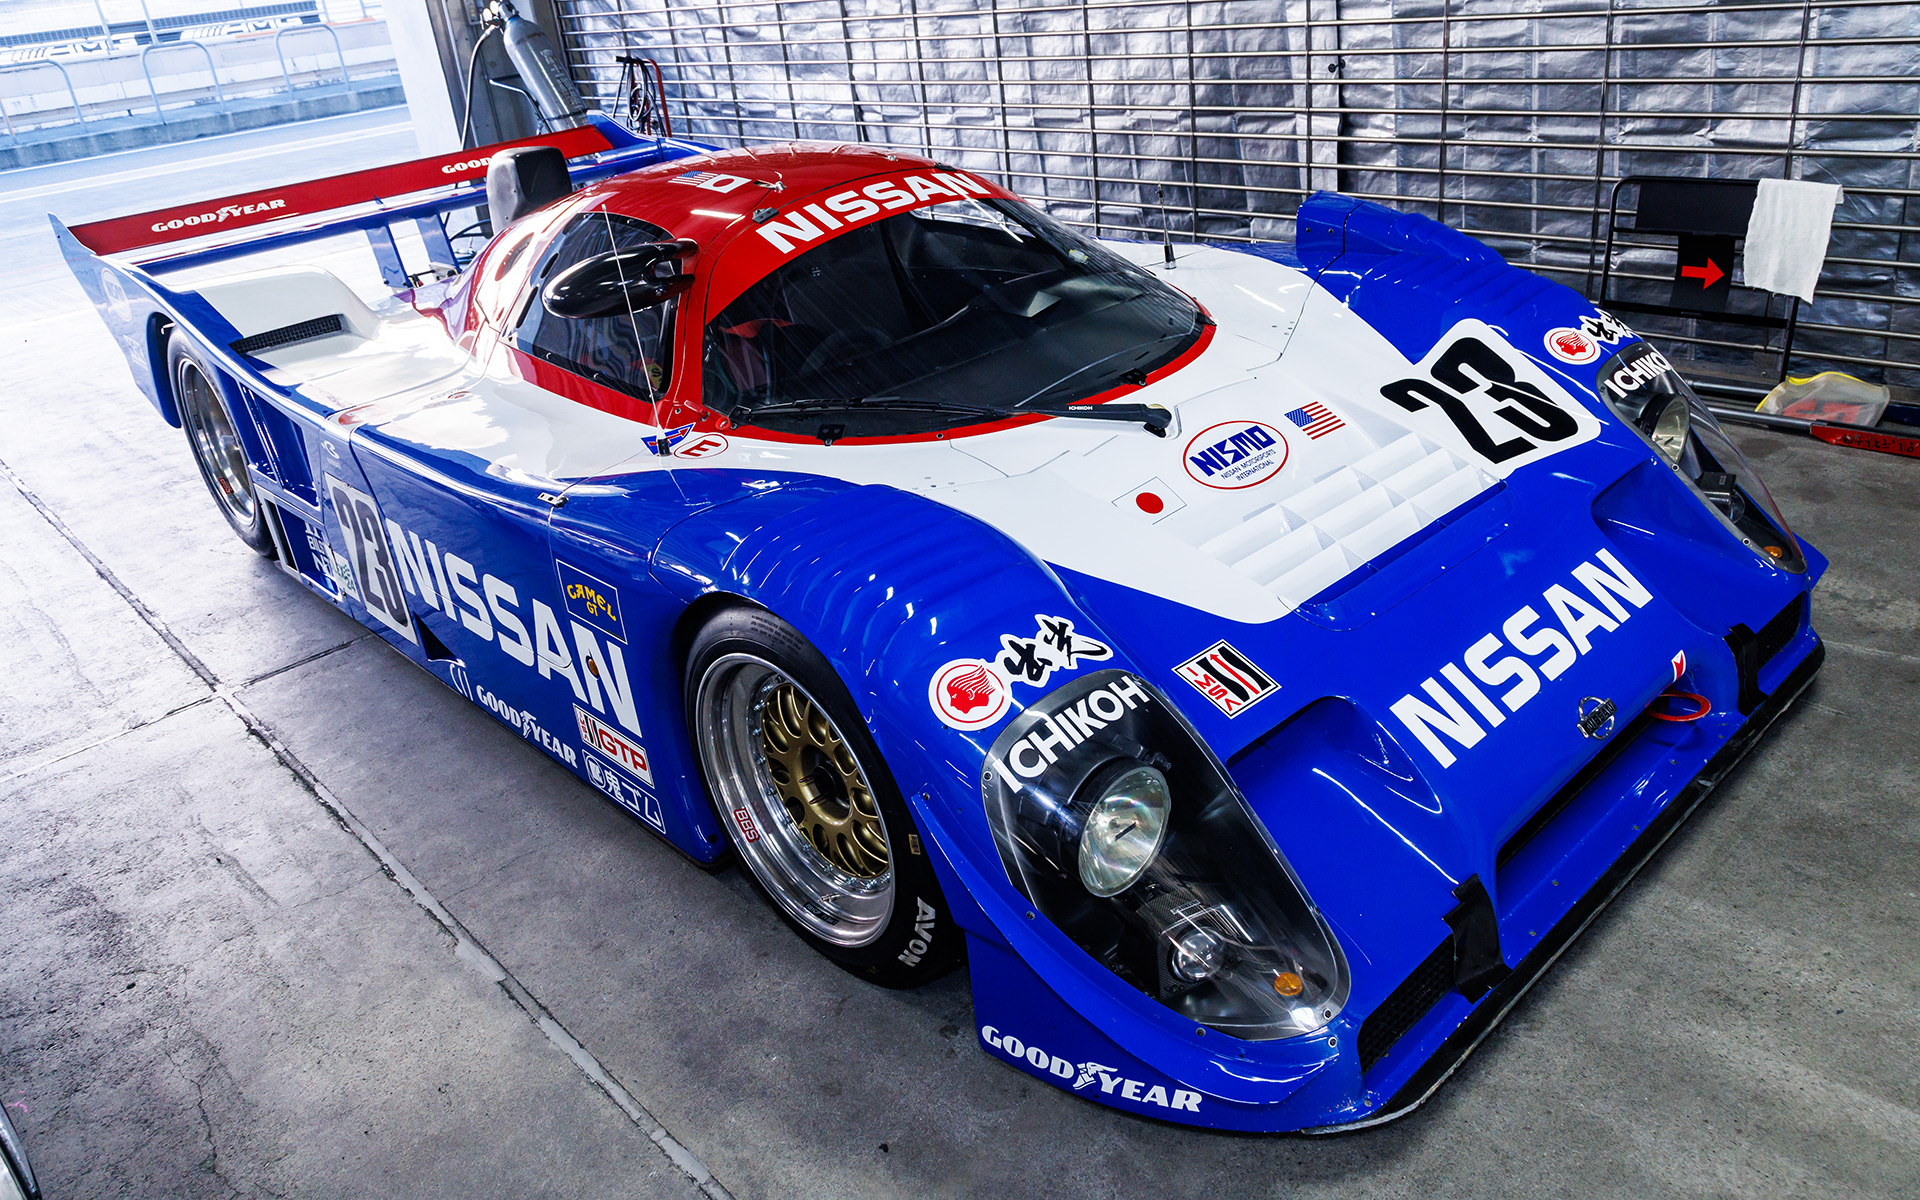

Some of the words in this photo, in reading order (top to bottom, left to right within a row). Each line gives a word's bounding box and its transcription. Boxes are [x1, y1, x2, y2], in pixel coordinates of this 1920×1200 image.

[151, 199, 286, 233] GOODYEAR
[755, 173, 991, 254] NISSAN
[1380, 337, 1579, 464] 23
[1189, 425, 1277, 477] NISMO
[1221, 465, 1241, 480] NISSAN
[1240, 449, 1277, 469] MOTORSPORTS
[1235, 460, 1275, 481] INTERNATIONAL
[333, 486, 408, 628] 23
[385, 518, 642, 737] NISSAN
[567, 584, 617, 622] CAMEL
[586, 601, 598, 617] GT
[1389, 547, 1654, 769] NISSAN
[1186, 666, 1242, 712] IMSA
[476, 685, 578, 768] GOODYEAR
[598, 728, 648, 771] GTP
[993, 675, 1150, 794] ICHIKOH
[604, 770, 662, 827] 鬼ゴム
[735, 810, 759, 840] BBS
[898, 896, 936, 967] AVON
[981, 1025, 1203, 1112] GOODYEAR
